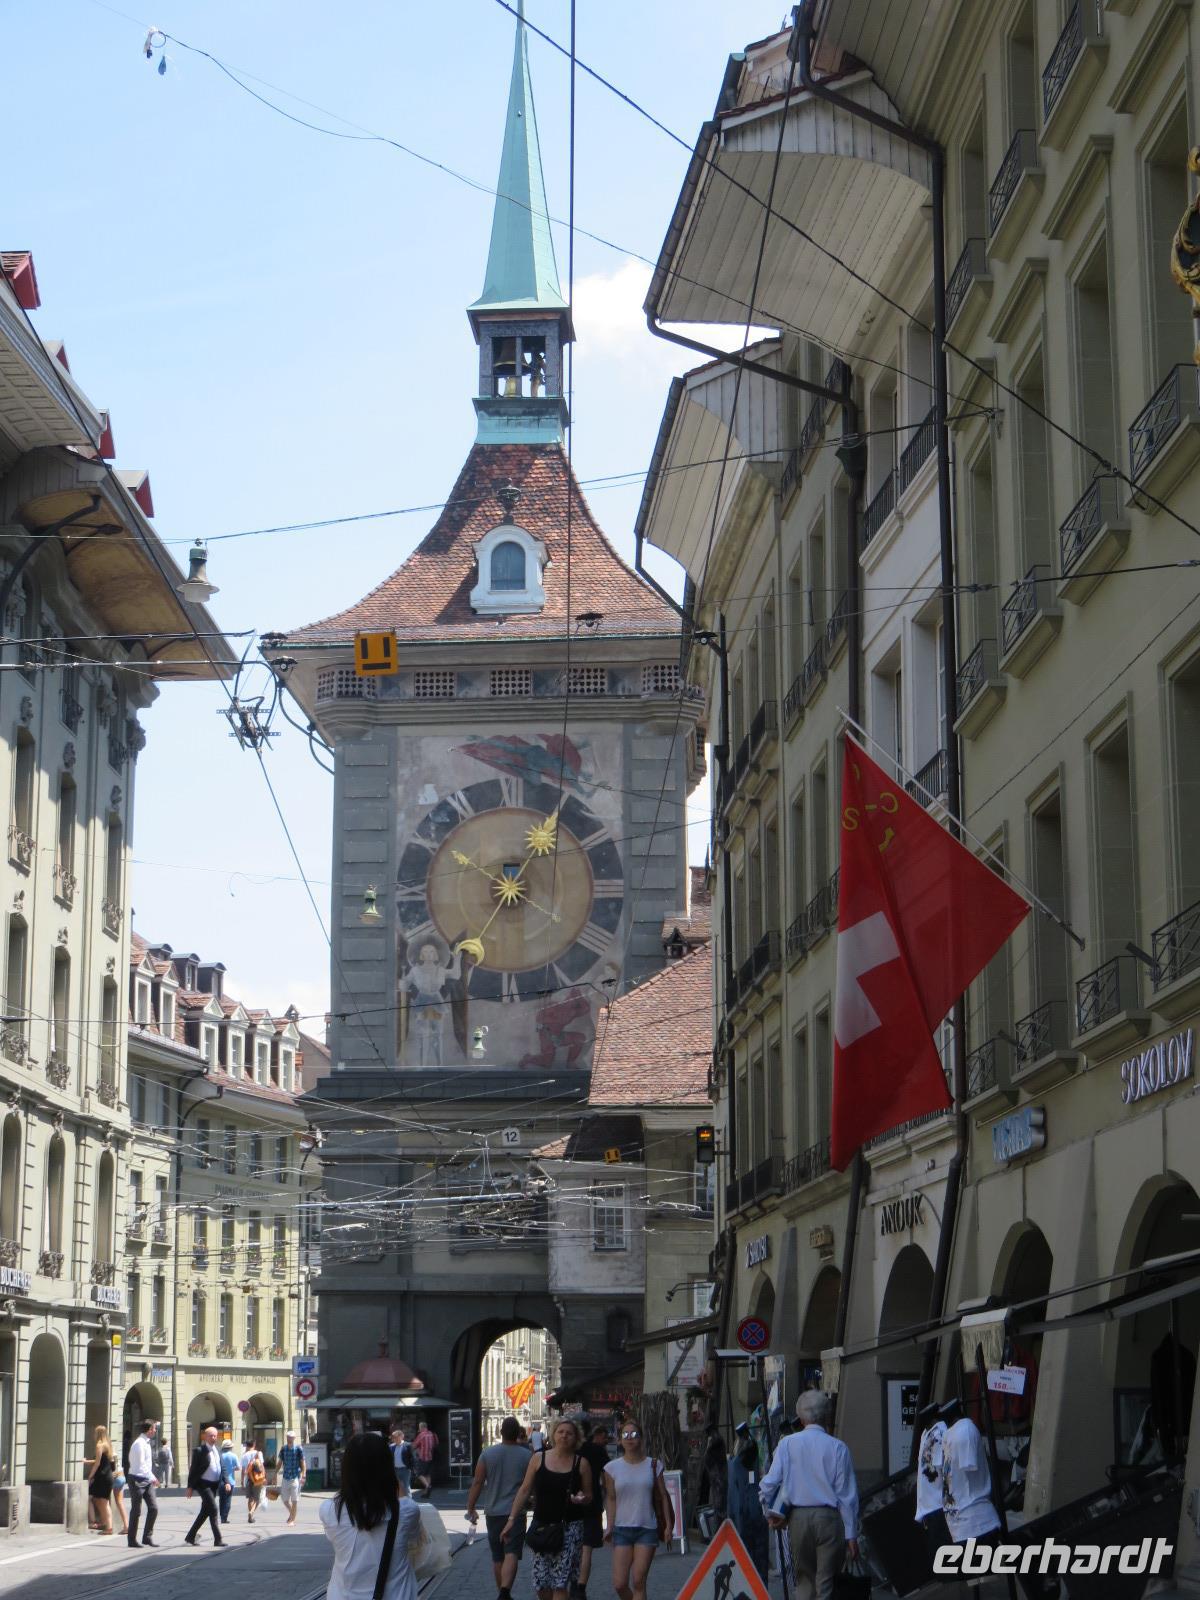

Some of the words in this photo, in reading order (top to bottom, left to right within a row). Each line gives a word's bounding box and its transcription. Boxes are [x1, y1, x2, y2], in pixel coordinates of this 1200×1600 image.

[1121, 1028, 1192, 1105] SOKOLOV
[504, 1131, 518, 1143] 12
[881, 1193, 925, 1236] ANOUK
